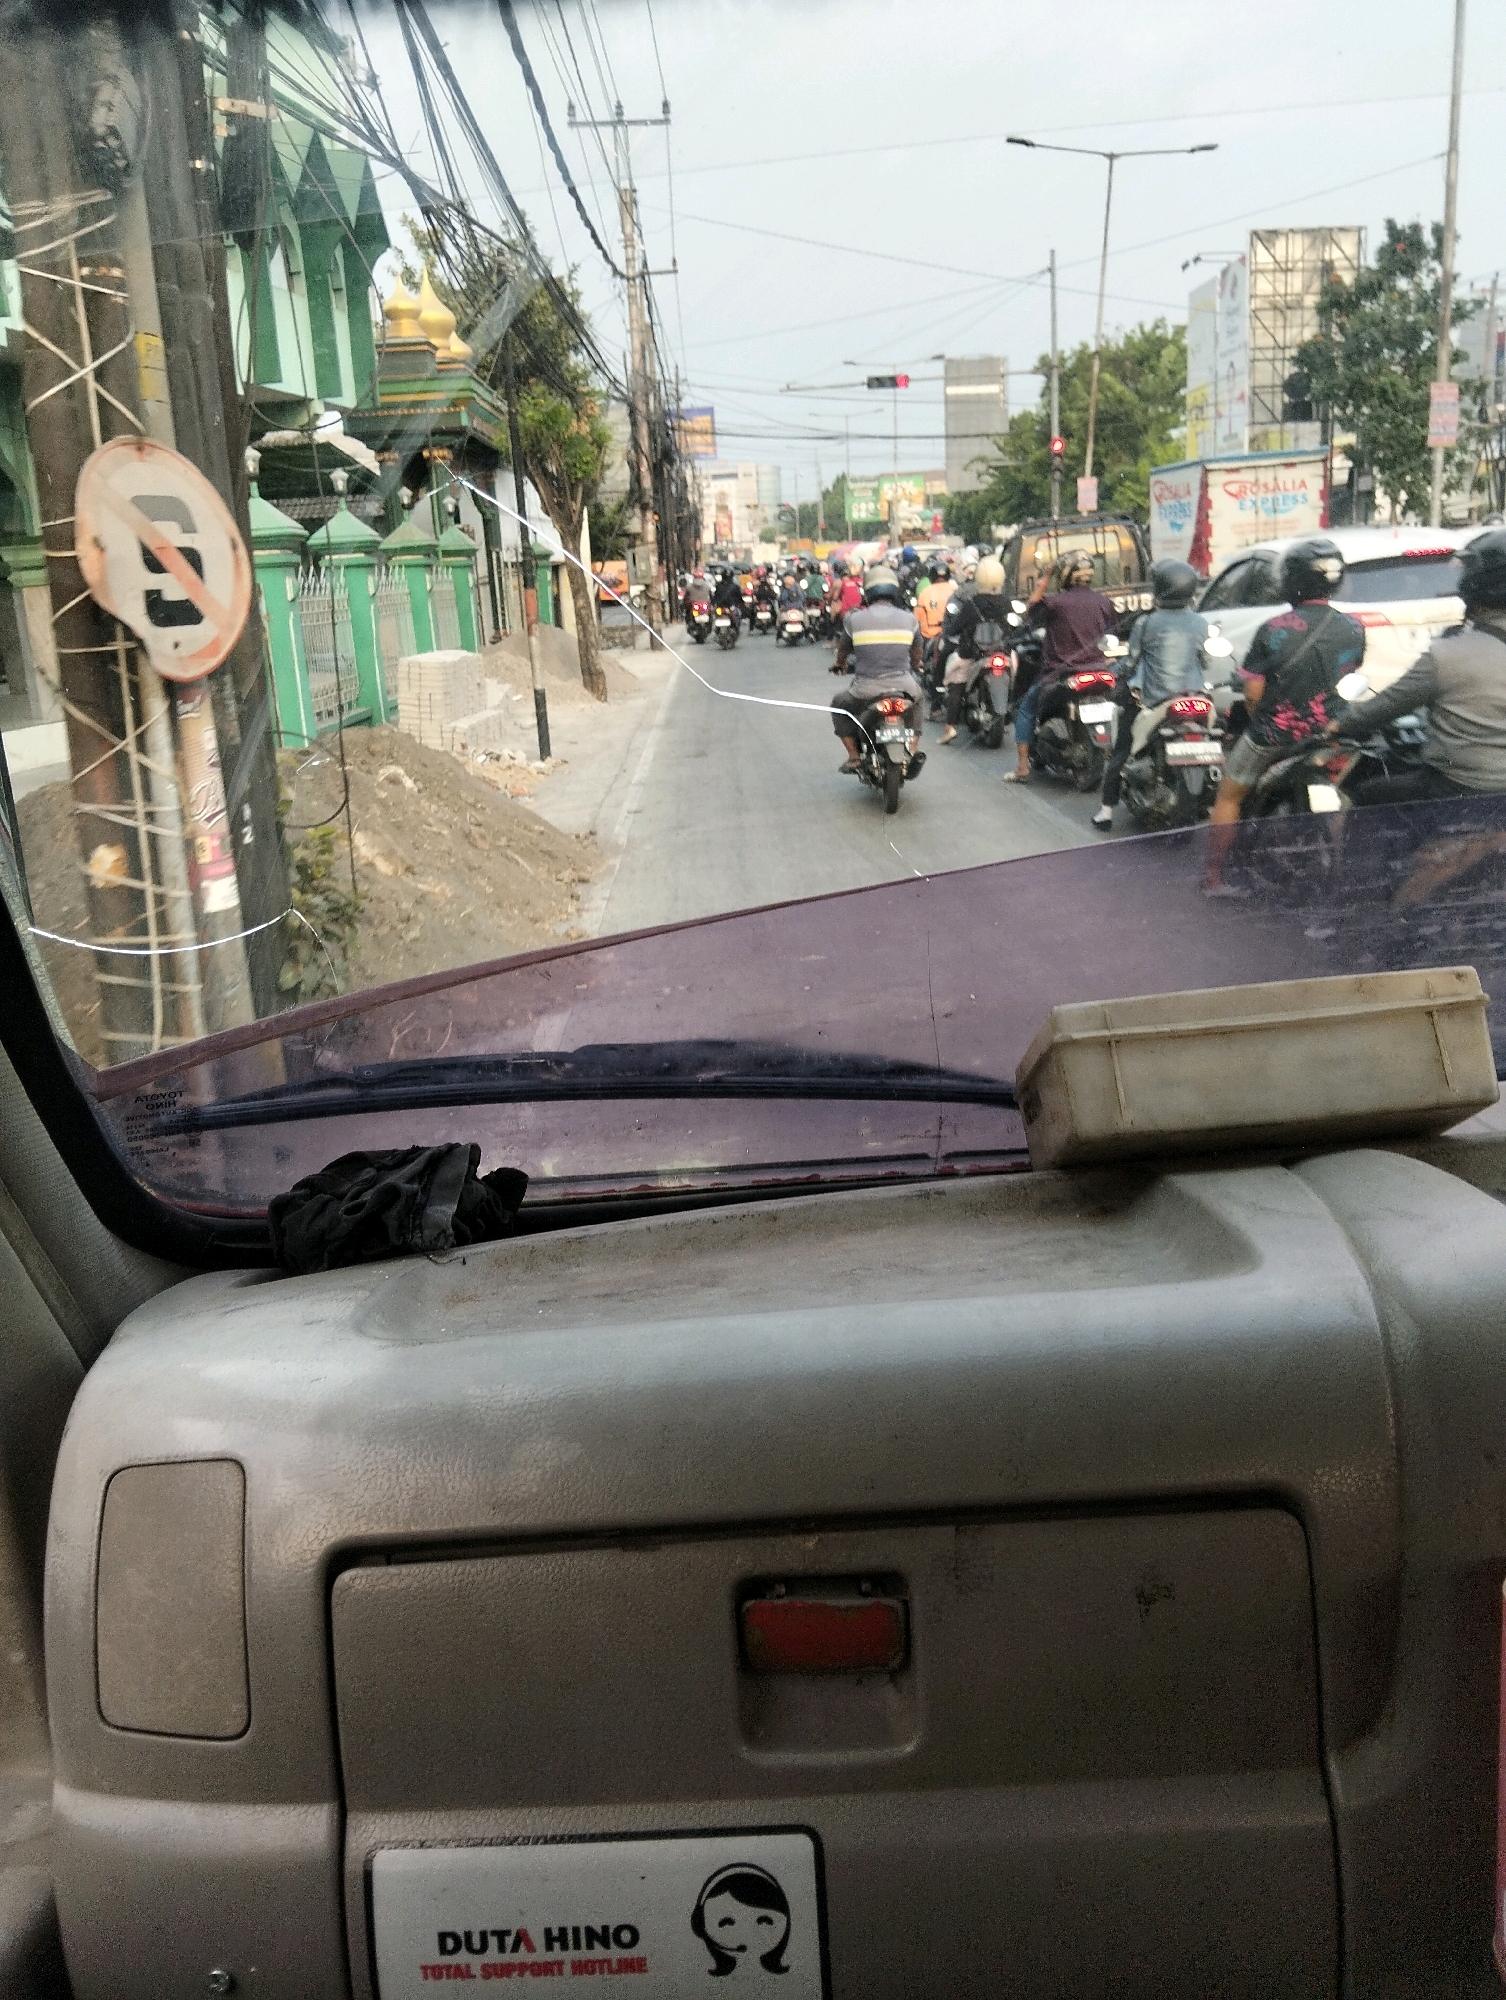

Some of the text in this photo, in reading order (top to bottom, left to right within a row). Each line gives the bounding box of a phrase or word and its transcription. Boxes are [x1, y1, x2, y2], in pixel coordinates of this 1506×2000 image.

[1223, 478, 1309, 499] ROSALIA
[1238, 493, 1309, 511] EXPRESS
[437, 1924, 640, 1956] DUTA HINO
[420, 1956, 648, 1981] TOTAL SUPPORT HOTLINE
